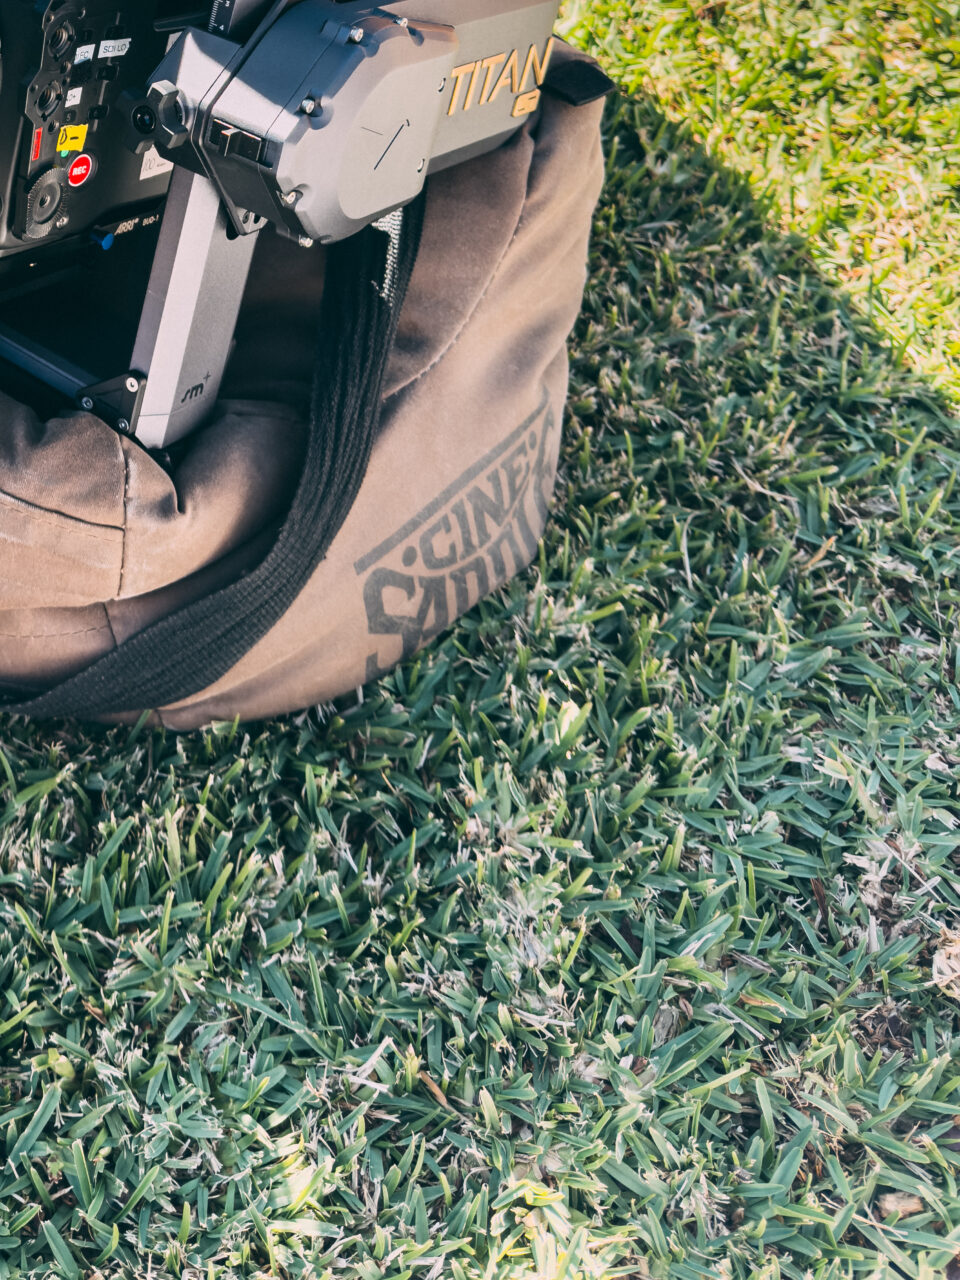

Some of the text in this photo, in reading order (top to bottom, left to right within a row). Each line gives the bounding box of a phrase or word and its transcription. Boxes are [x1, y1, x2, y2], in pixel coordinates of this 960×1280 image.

[446, 36, 555, 117] TITAN
[72, 165, 87, 176] REC
[419, 438, 532, 571] CINE
